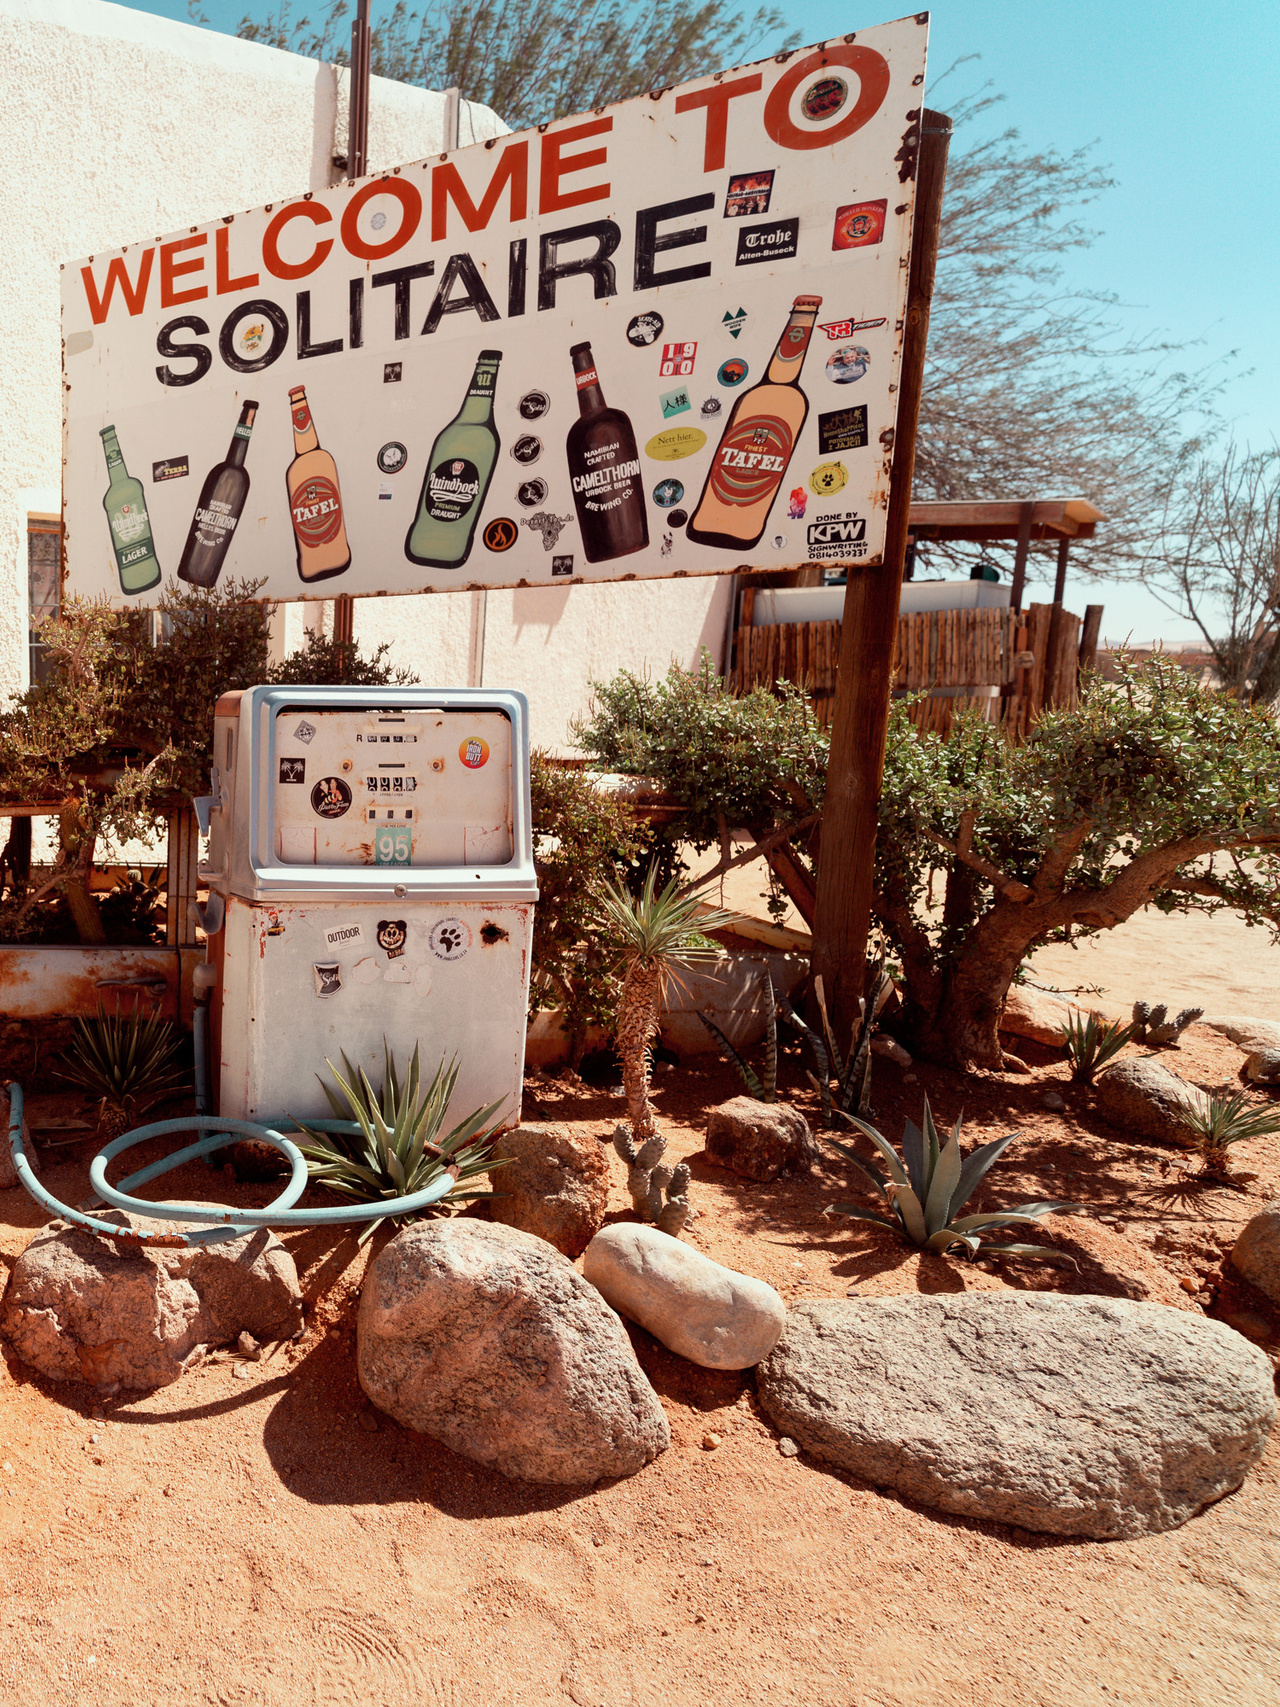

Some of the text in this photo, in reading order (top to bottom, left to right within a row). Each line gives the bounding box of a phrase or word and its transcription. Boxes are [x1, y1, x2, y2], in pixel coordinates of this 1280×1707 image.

[81, 45, 891, 325] WELCOME TO
[745, 229, 792, 248] Trohe
[739, 246, 795, 261] Alten-Buseck
[155, 192, 715, 387] SOLITAIRE
[576, 371, 597, 385] URBOCK
[657, 436, 675, 445] Nett
[677, 433, 694, 441] hier.
[584, 442, 620, 459] NAMIBIAN
[744, 444, 768, 453] FINEST
[587, 451, 615, 466] CRAFTED
[720, 446, 785, 473] TAFEL
[430, 472, 479, 495] Windhoek
[572, 459, 640, 493] CAMELTHORN
[585, 479, 631, 498] URBOCK BEER
[293, 498, 339, 523] TAFEL
[434, 502, 460, 511] PREMIUM
[585, 497, 622, 512] BREWING
[195, 508, 237, 530] CAMELTHORN
[430, 508, 461, 519] DRAUGHT
[816, 513, 842, 522] DONE
[809, 521, 863, 543] KPW
[122, 546, 148, 564] LAGER
[807, 541, 869, 553] SIGNWRITING
[356, 734, 363, 742] R
[465, 752, 483, 762] BUTT
[467, 744, 482, 754] IRON
[379, 835, 409, 861] 95
[327, 926, 361, 944] OUTDOOR
